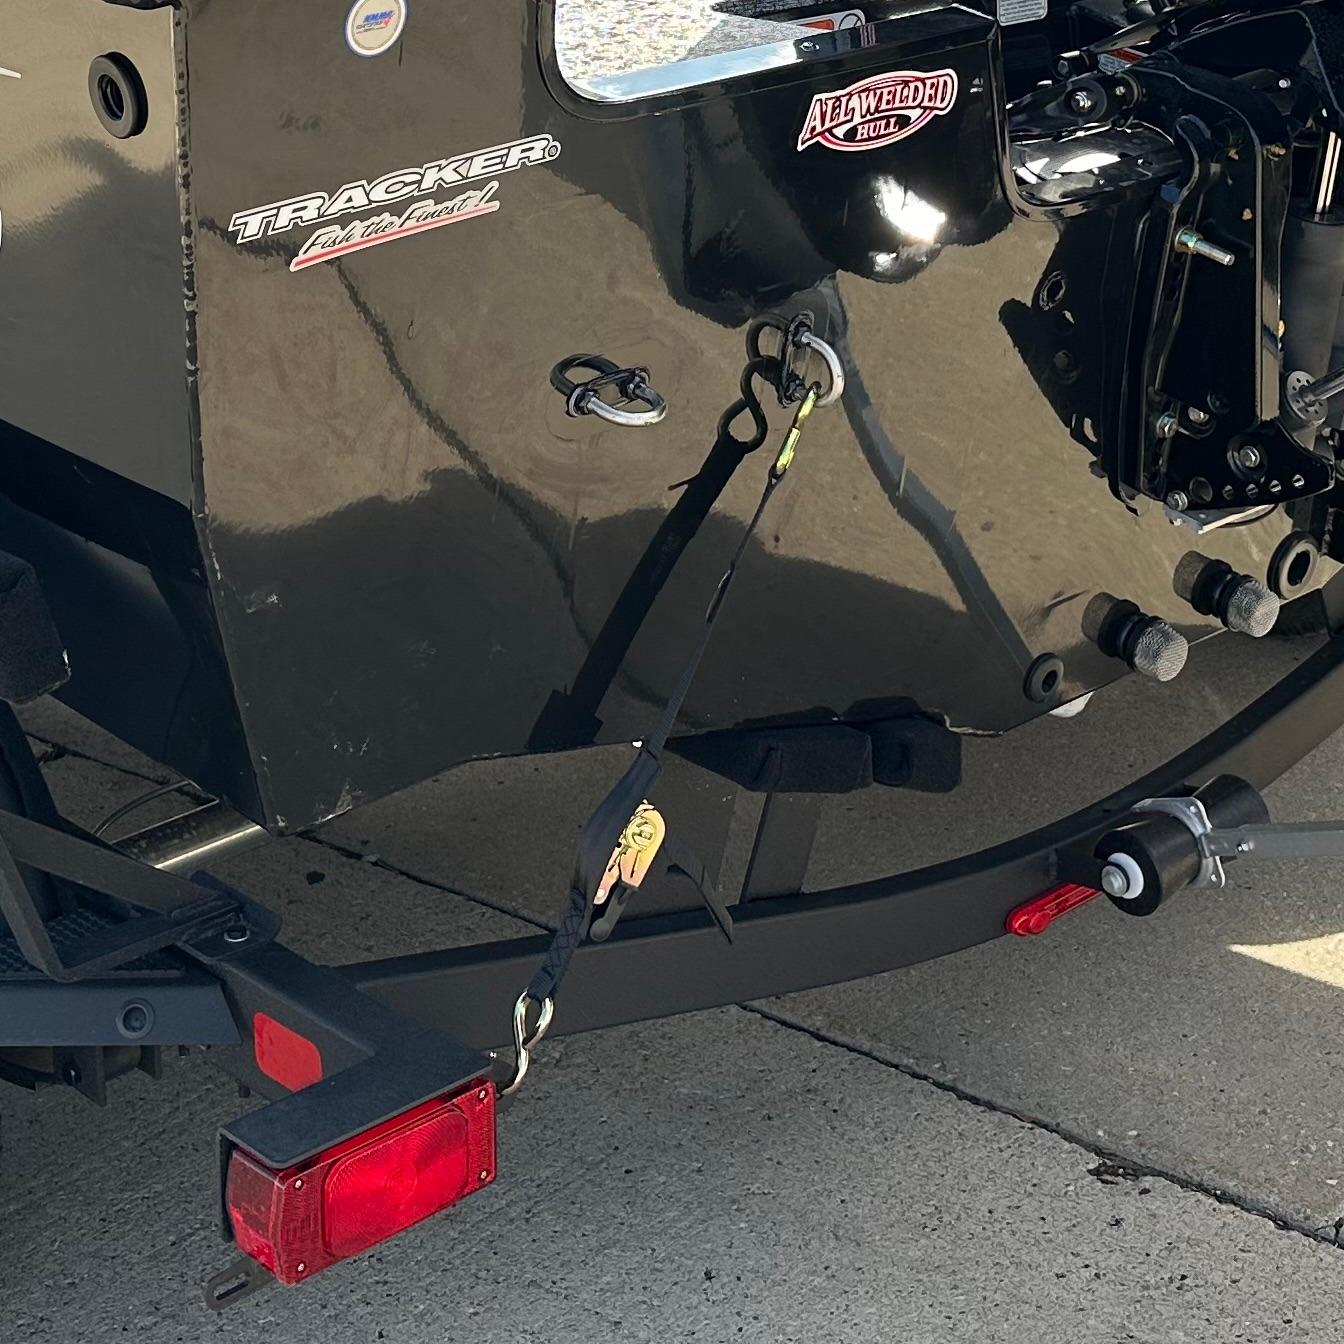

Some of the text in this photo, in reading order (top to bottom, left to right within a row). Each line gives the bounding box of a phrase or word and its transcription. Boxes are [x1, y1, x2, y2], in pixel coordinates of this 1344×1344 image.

[802, 74, 953, 144] ALL WELDED
[855, 116, 899, 141] HULL
[302, 225, 358, 255] Fish
[360, 216, 397, 240] the
